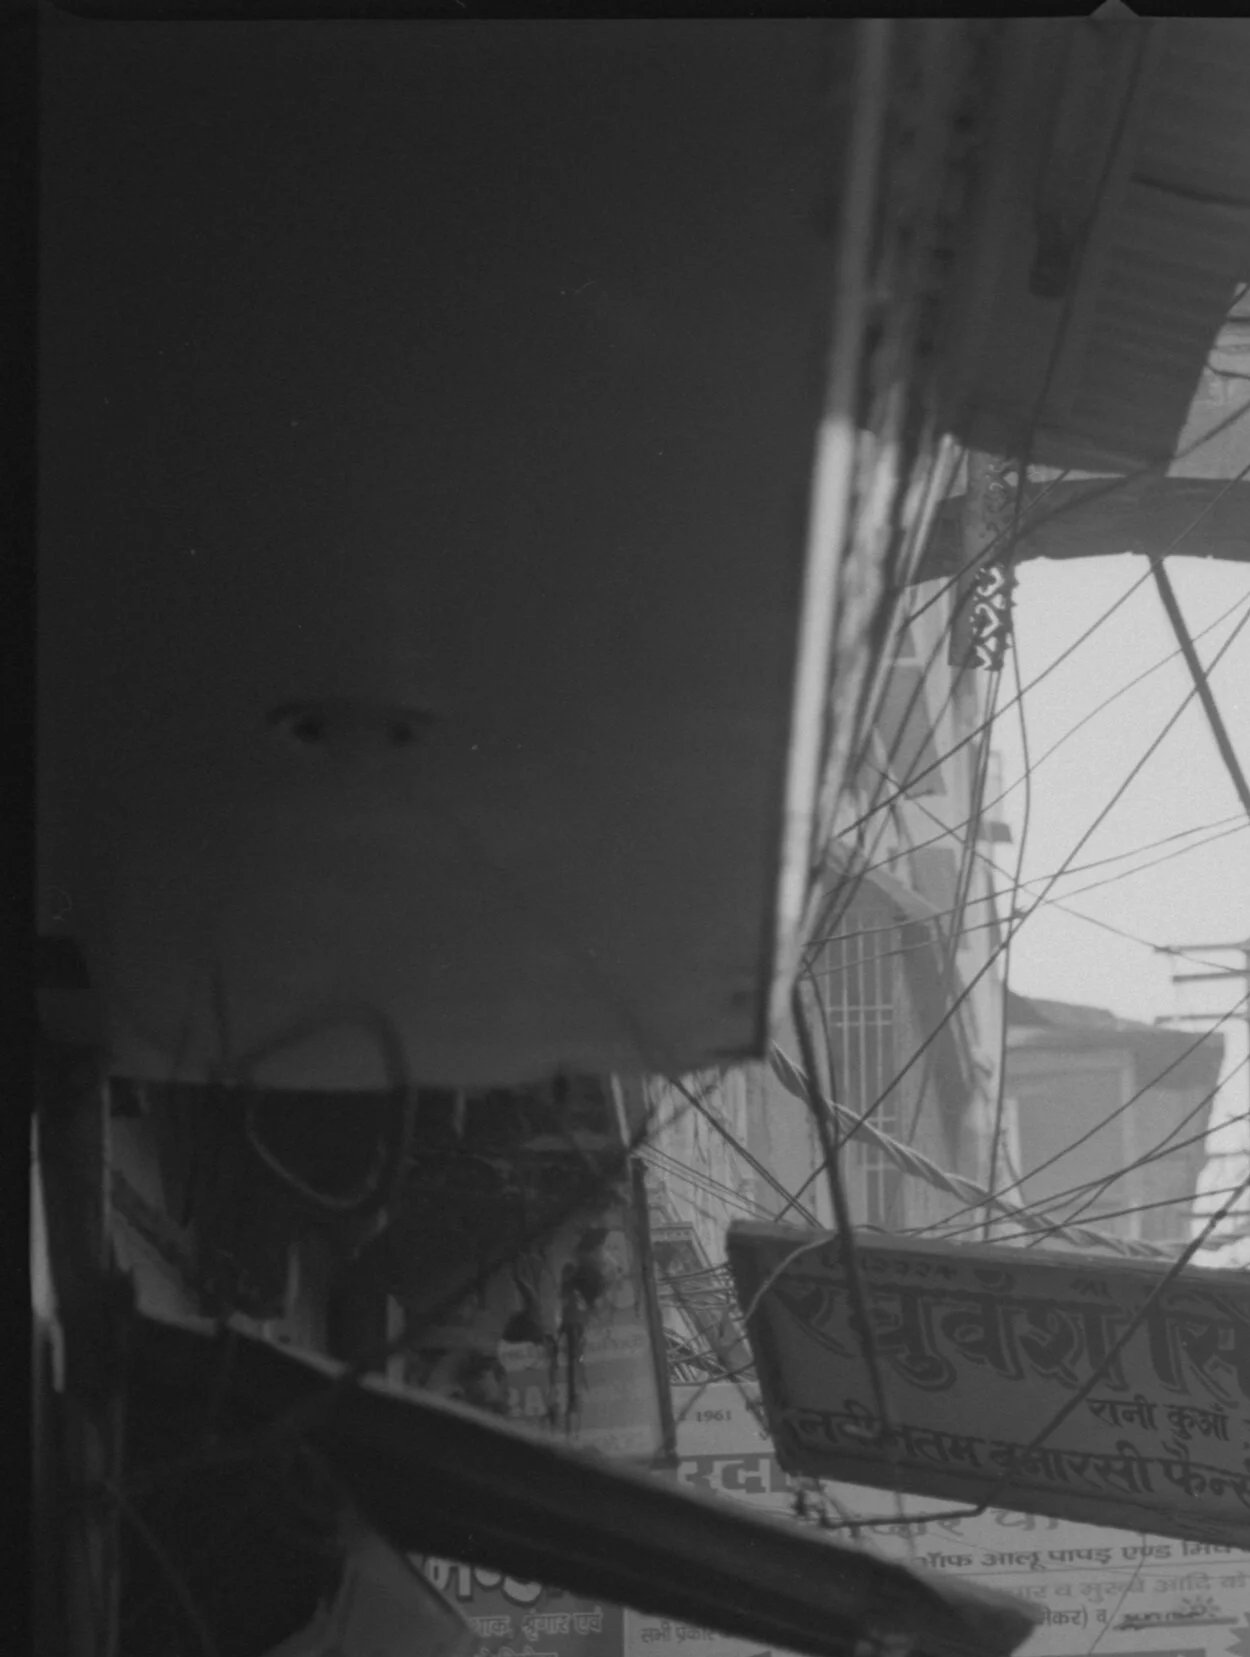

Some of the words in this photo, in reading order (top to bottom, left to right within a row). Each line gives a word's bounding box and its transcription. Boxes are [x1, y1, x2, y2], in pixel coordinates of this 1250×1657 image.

[696, 1409, 733, 1422] 1961
[1086, 1396, 1159, 1431] रानी
[980, 1550, 1047, 1570] आलू
[1055, 1582, 1073, 1597] व
[573, 1605, 604, 1635] एवं
